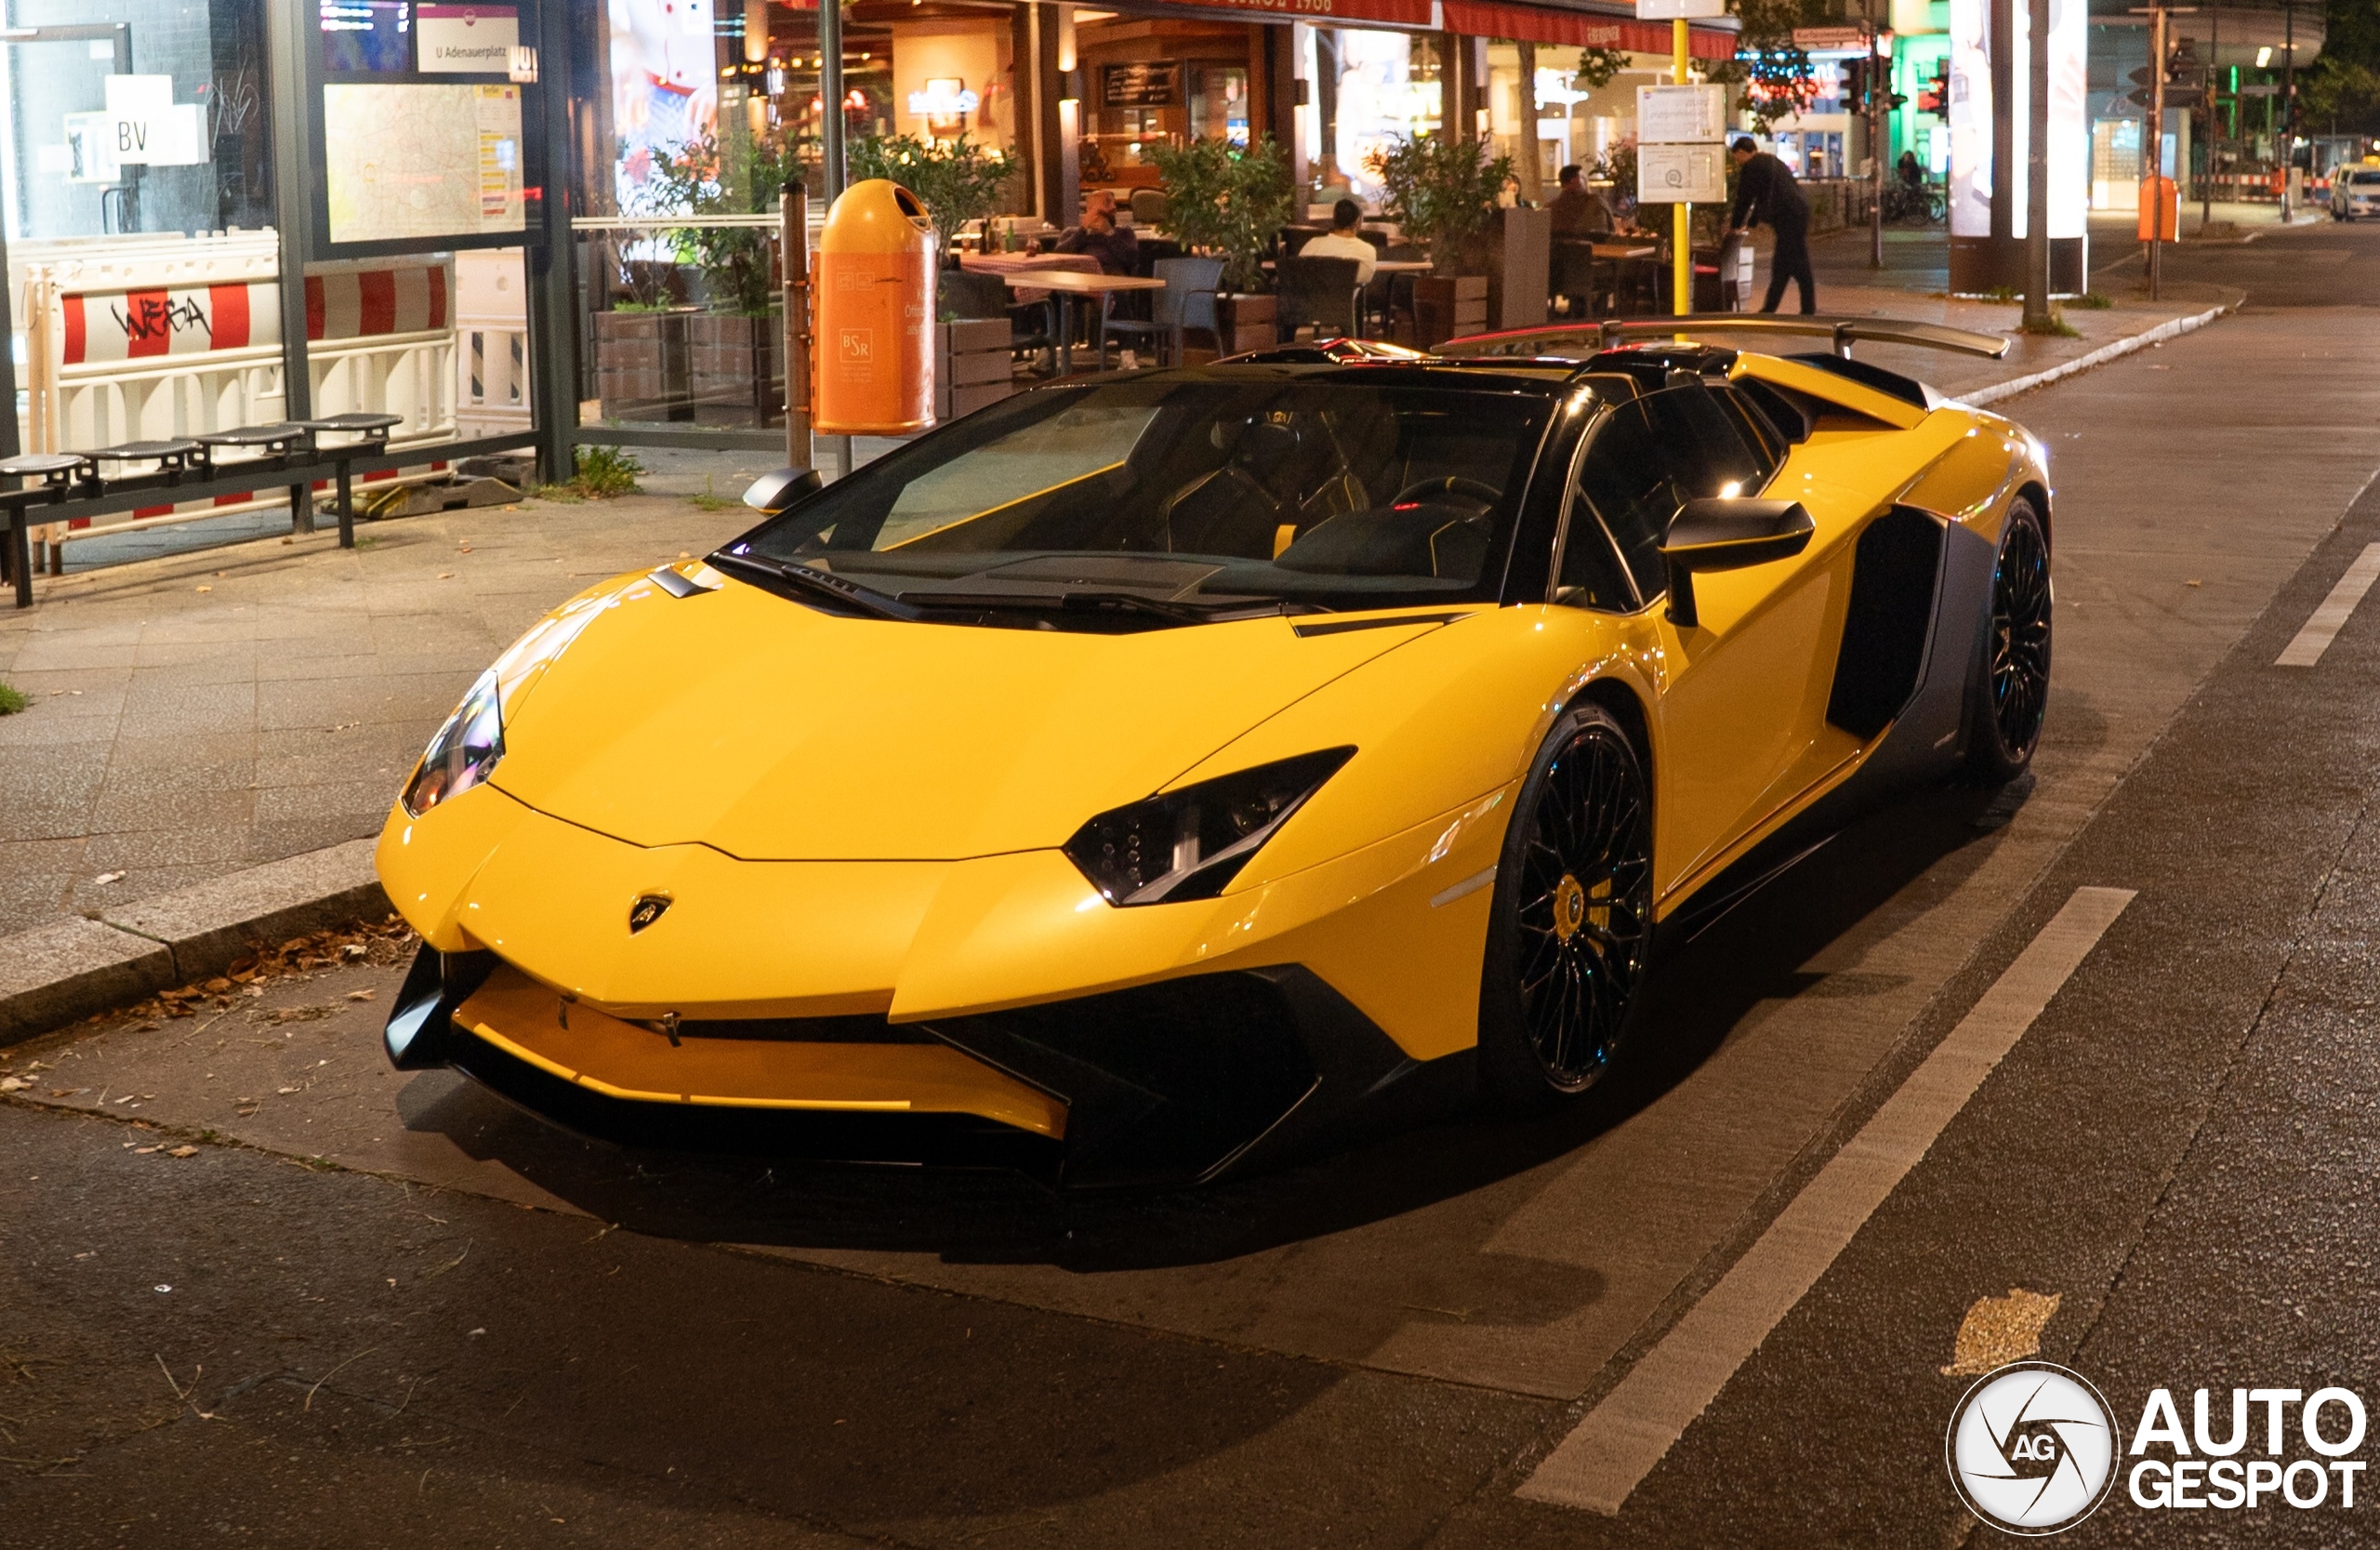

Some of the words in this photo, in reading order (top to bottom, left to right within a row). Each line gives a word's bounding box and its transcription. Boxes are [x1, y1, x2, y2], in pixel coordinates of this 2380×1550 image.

[436, 46, 443, 59] U
[444, 46, 507, 60] Adenauerplatz
[842, 335, 868, 356] BSR
